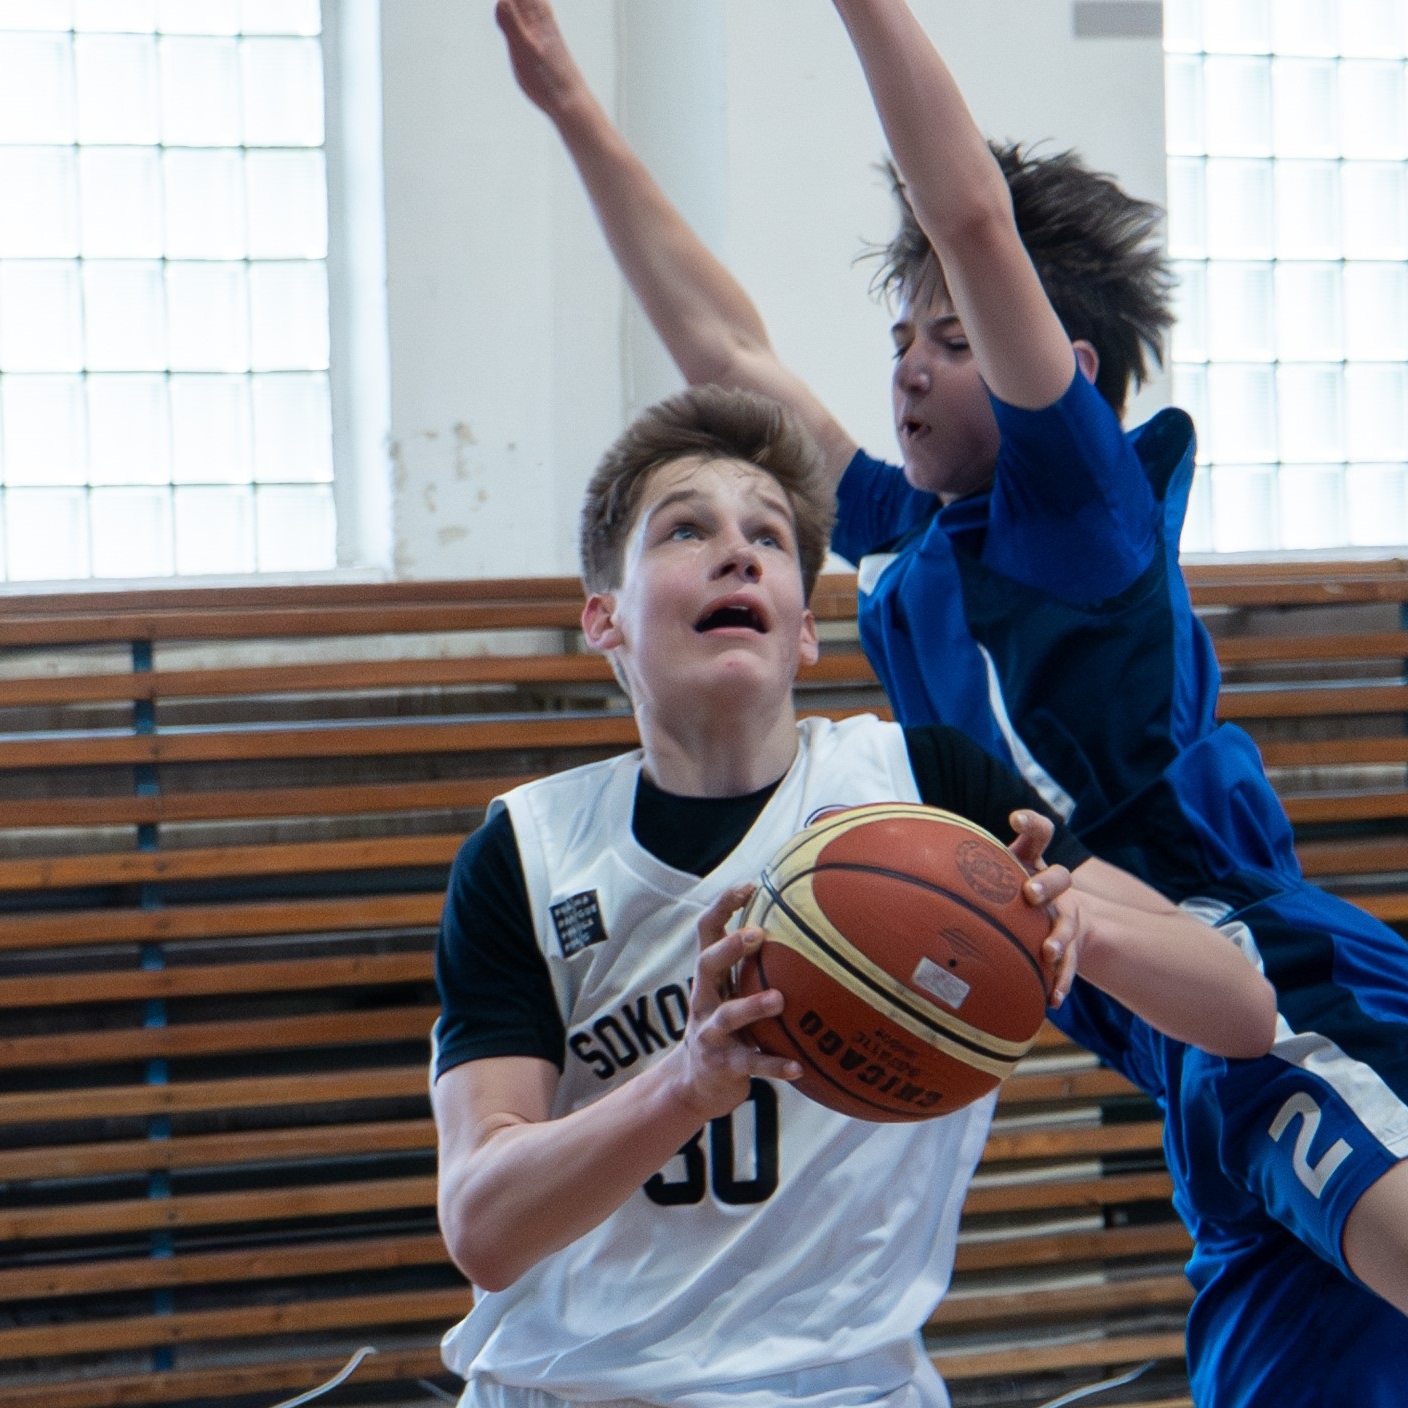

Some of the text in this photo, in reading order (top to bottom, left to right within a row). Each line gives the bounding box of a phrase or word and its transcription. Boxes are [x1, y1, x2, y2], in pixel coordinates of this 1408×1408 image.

[569, 976, 695, 1080] SOKO
[799, 1010, 943, 1108] CHICAGO
[1268, 1091, 1353, 1199] 2
